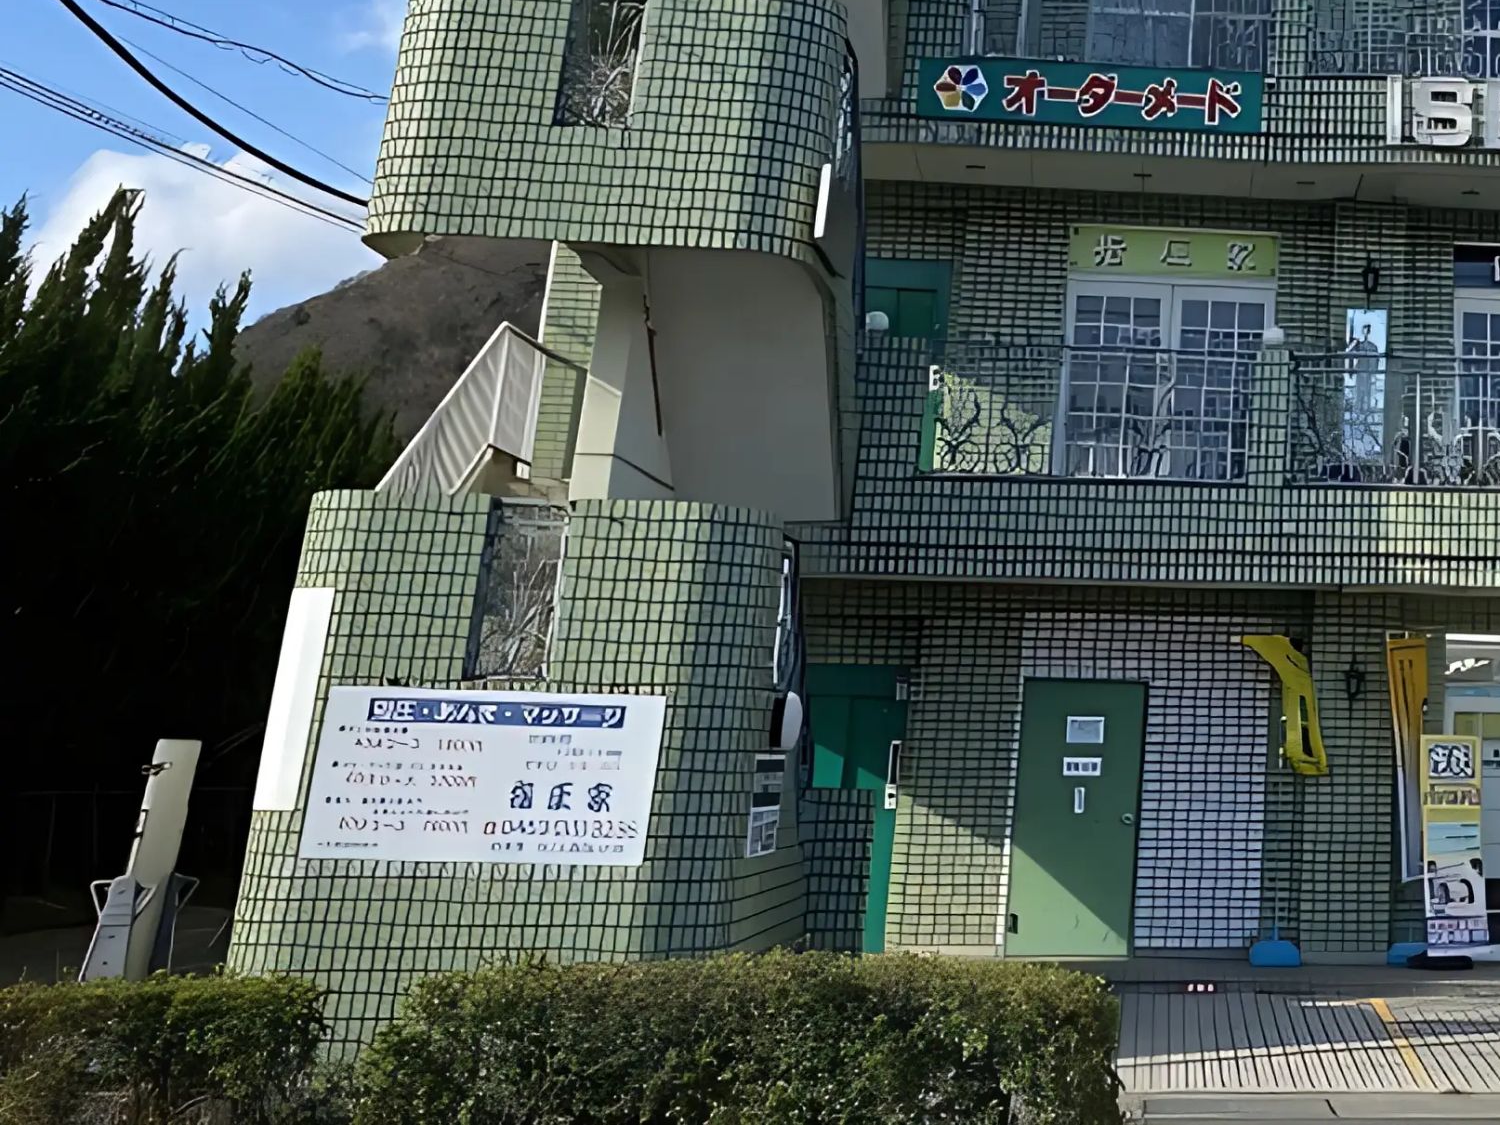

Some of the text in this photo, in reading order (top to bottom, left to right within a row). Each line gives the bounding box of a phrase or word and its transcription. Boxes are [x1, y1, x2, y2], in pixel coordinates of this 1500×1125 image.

[1001, 70, 1242, 126] オーダーメード
